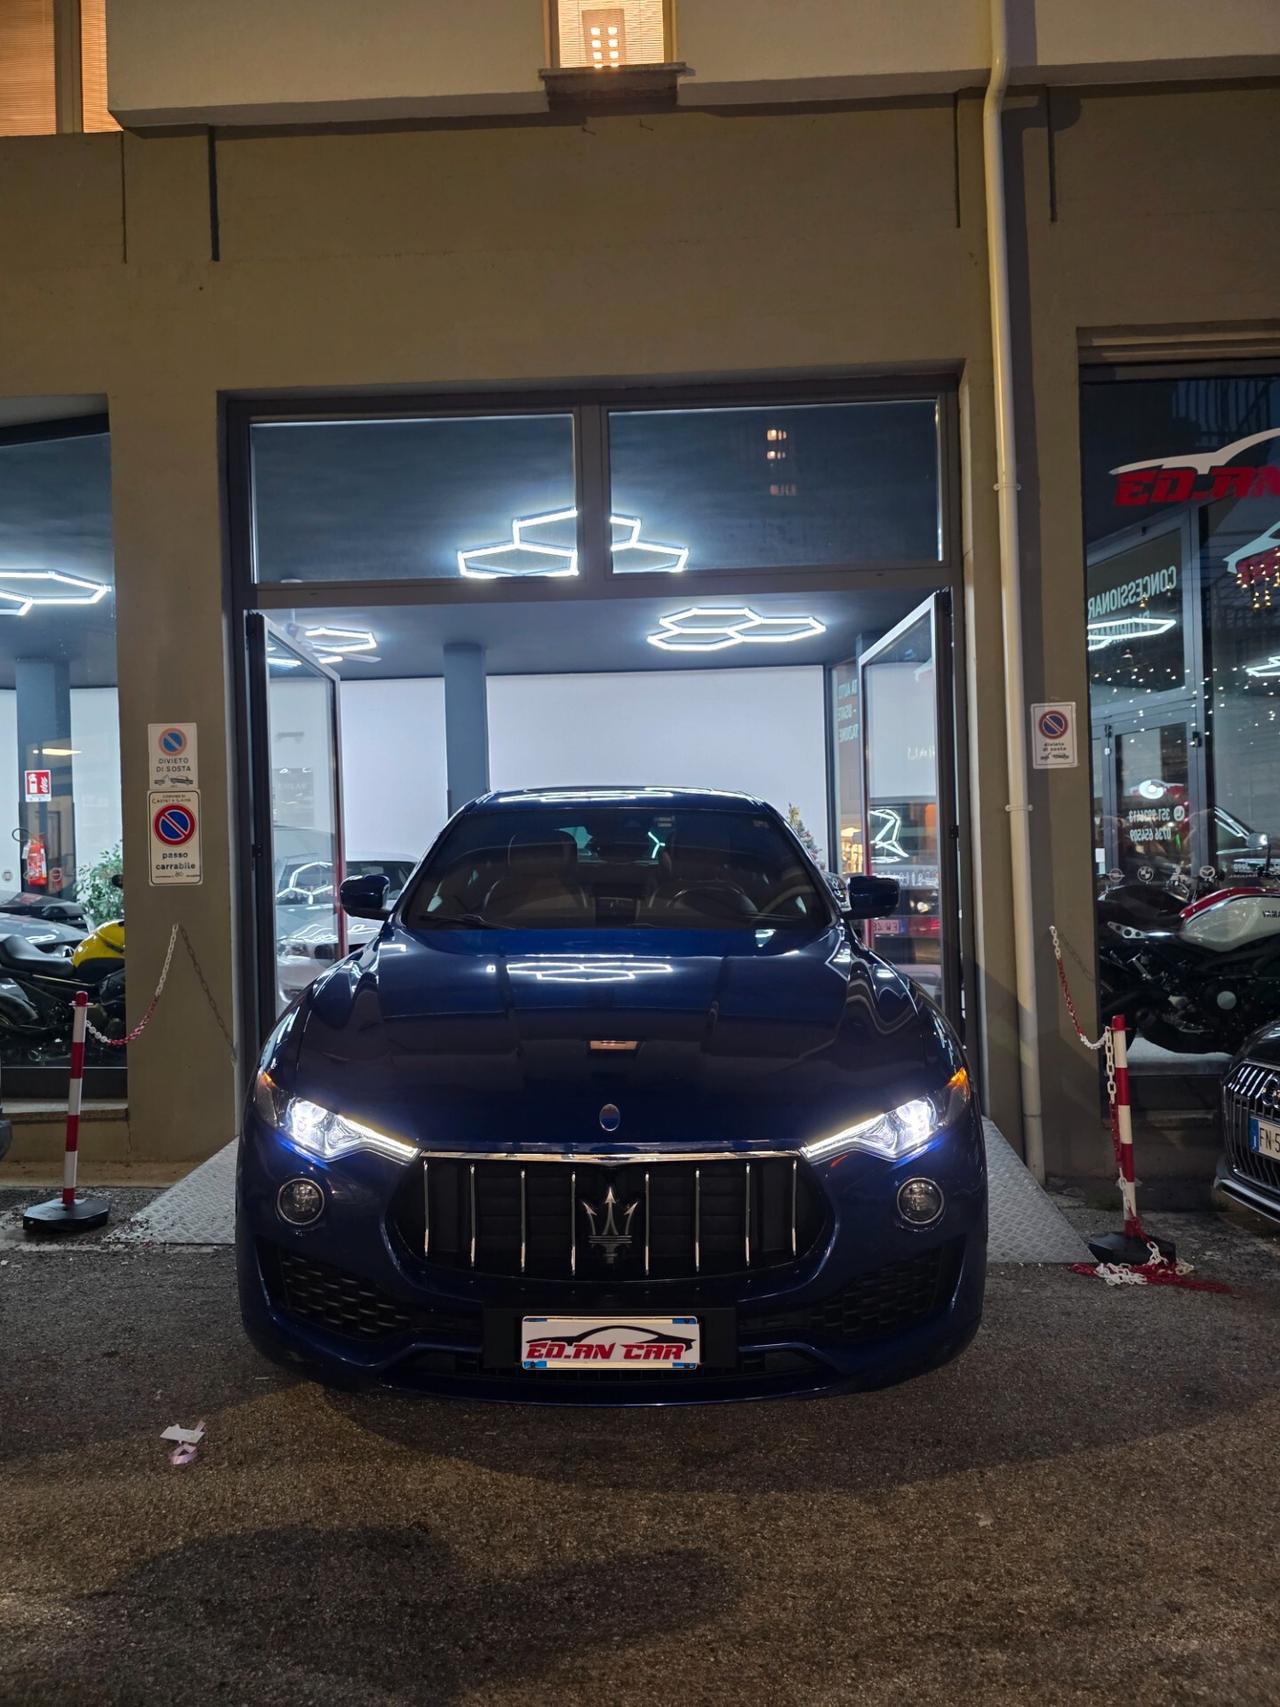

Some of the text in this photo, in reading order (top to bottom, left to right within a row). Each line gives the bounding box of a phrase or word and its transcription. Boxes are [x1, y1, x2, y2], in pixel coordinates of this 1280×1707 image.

[159, 756, 189, 764] DIVIETO
[162, 851, 188, 859] passo
[155, 862, 196, 870] carrabile
[1259, 1128, 1272, 1151] FN
[525, 1341, 684, 1360] ED.AN CAR
